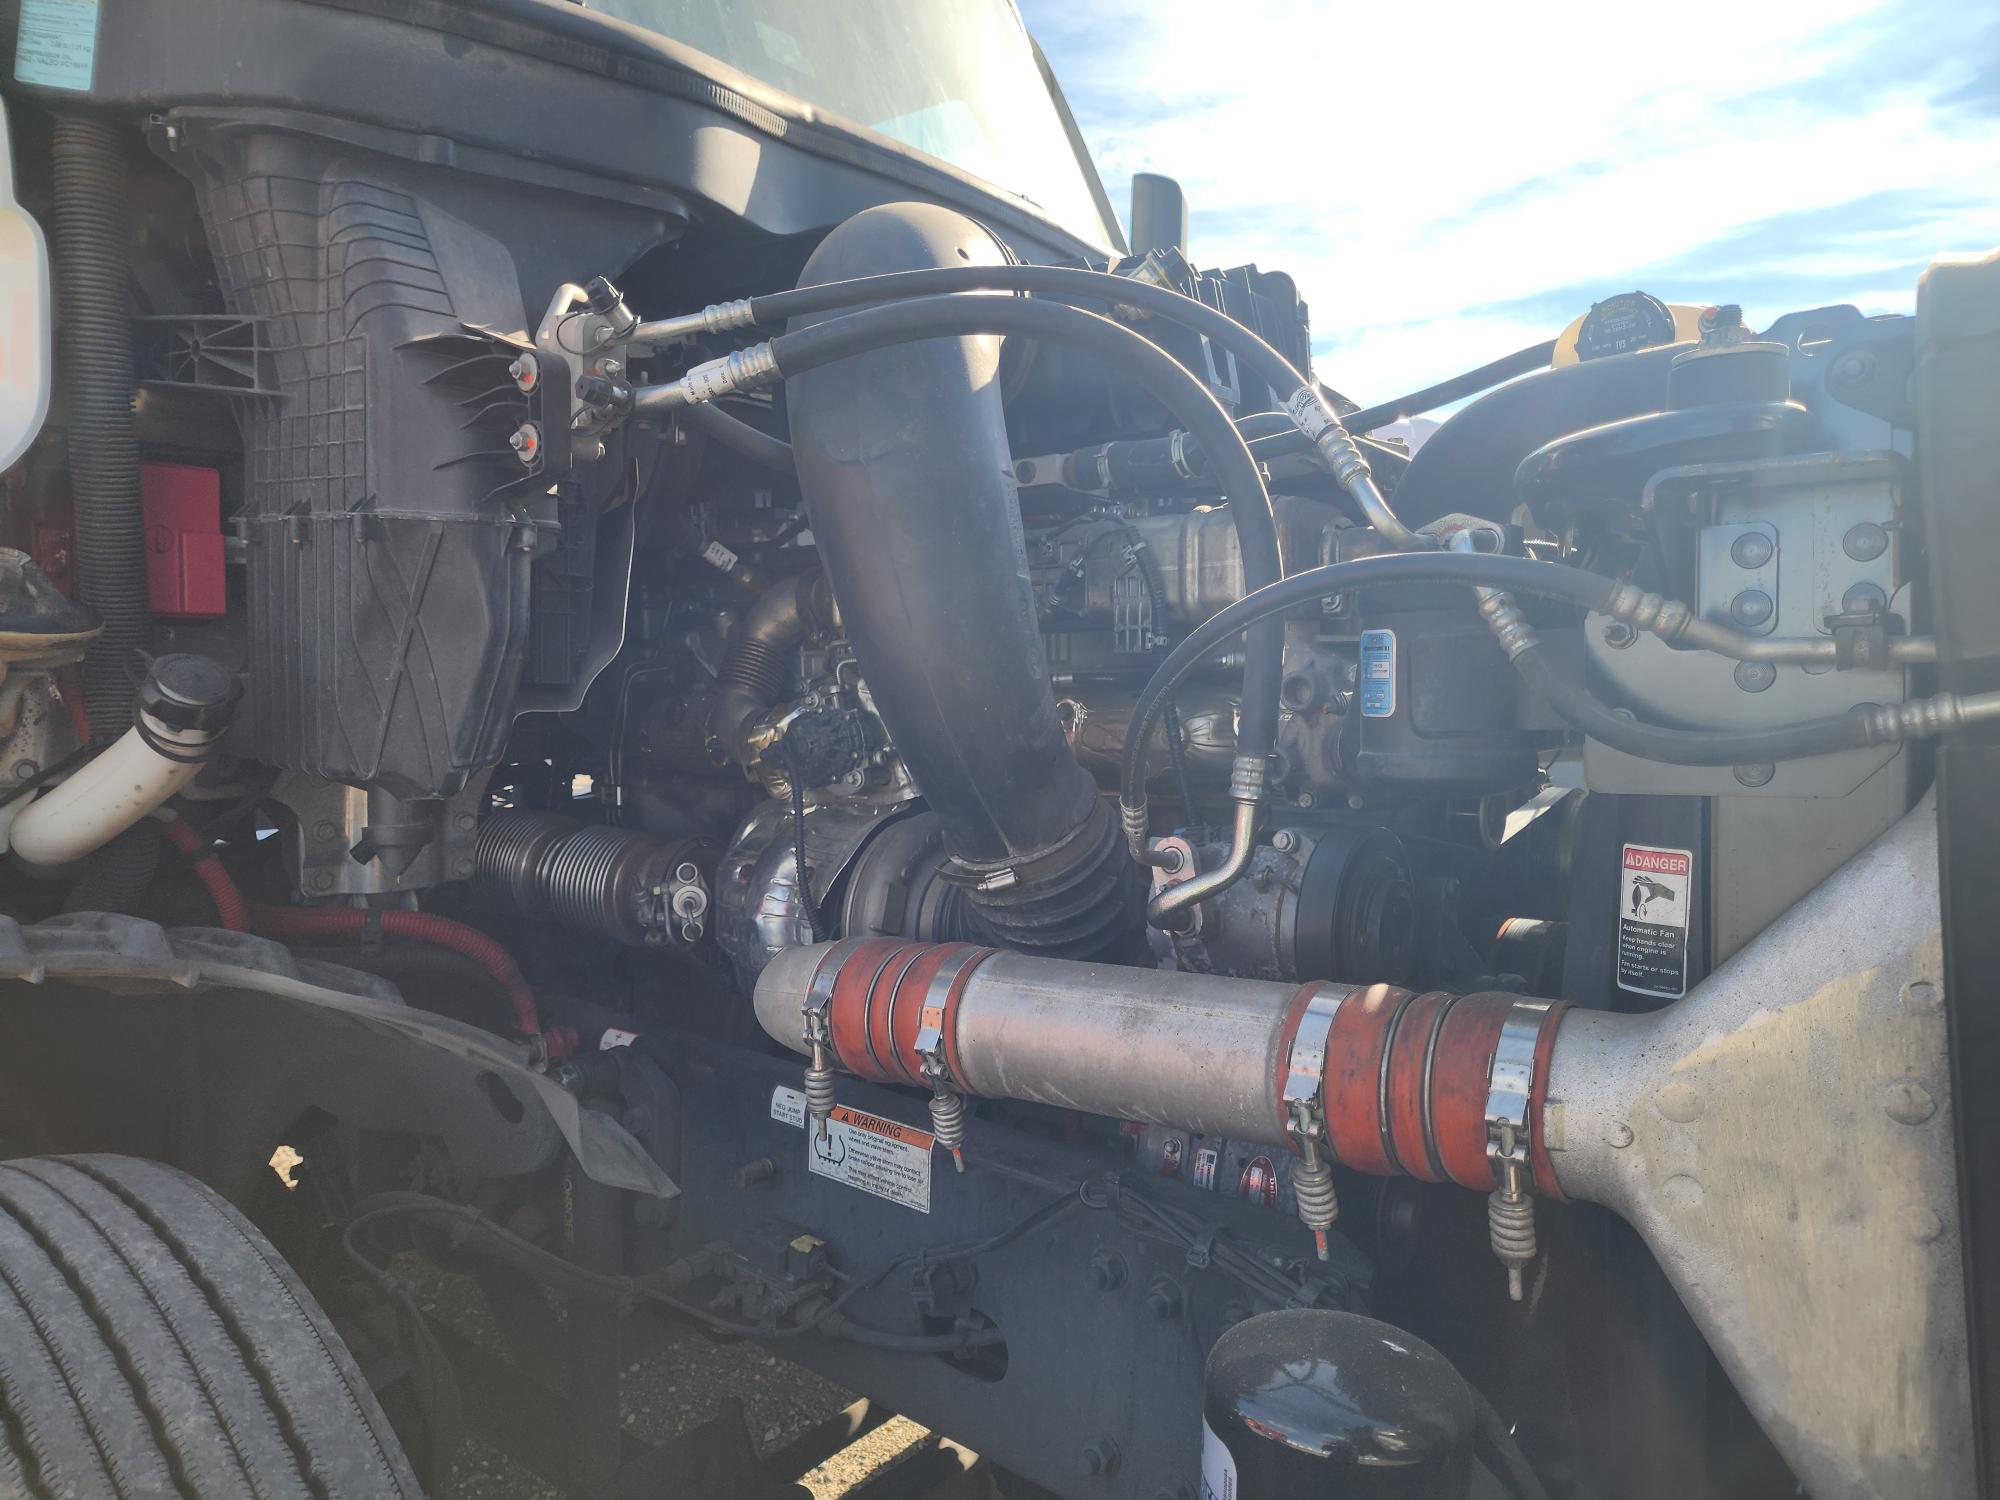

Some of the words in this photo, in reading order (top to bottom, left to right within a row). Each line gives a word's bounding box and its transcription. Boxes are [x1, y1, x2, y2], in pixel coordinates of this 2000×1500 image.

[1635, 855, 1687, 871] DANGER
[1622, 923, 1657, 936] Automatic
[1660, 929, 1675, 938] Fan
[1622, 934, 1636, 943] Keep
[1636, 937, 1657, 946] hands
[1658, 941, 1675, 949] clear
[1636, 946, 1659, 954] engine
[1621, 959, 1631, 967] Fan
[1631, 963, 1649, 971] starts
[1659, 967, 1679, 976] stops
[773, 1109, 788, 1118] START
[789, 1114, 803, 1124] STUD
[852, 1113, 902, 1138] WARNING
[848, 1127, 857, 1136] Use
[857, 1130, 867, 1140] only
[867, 1133, 884, 1143] original
